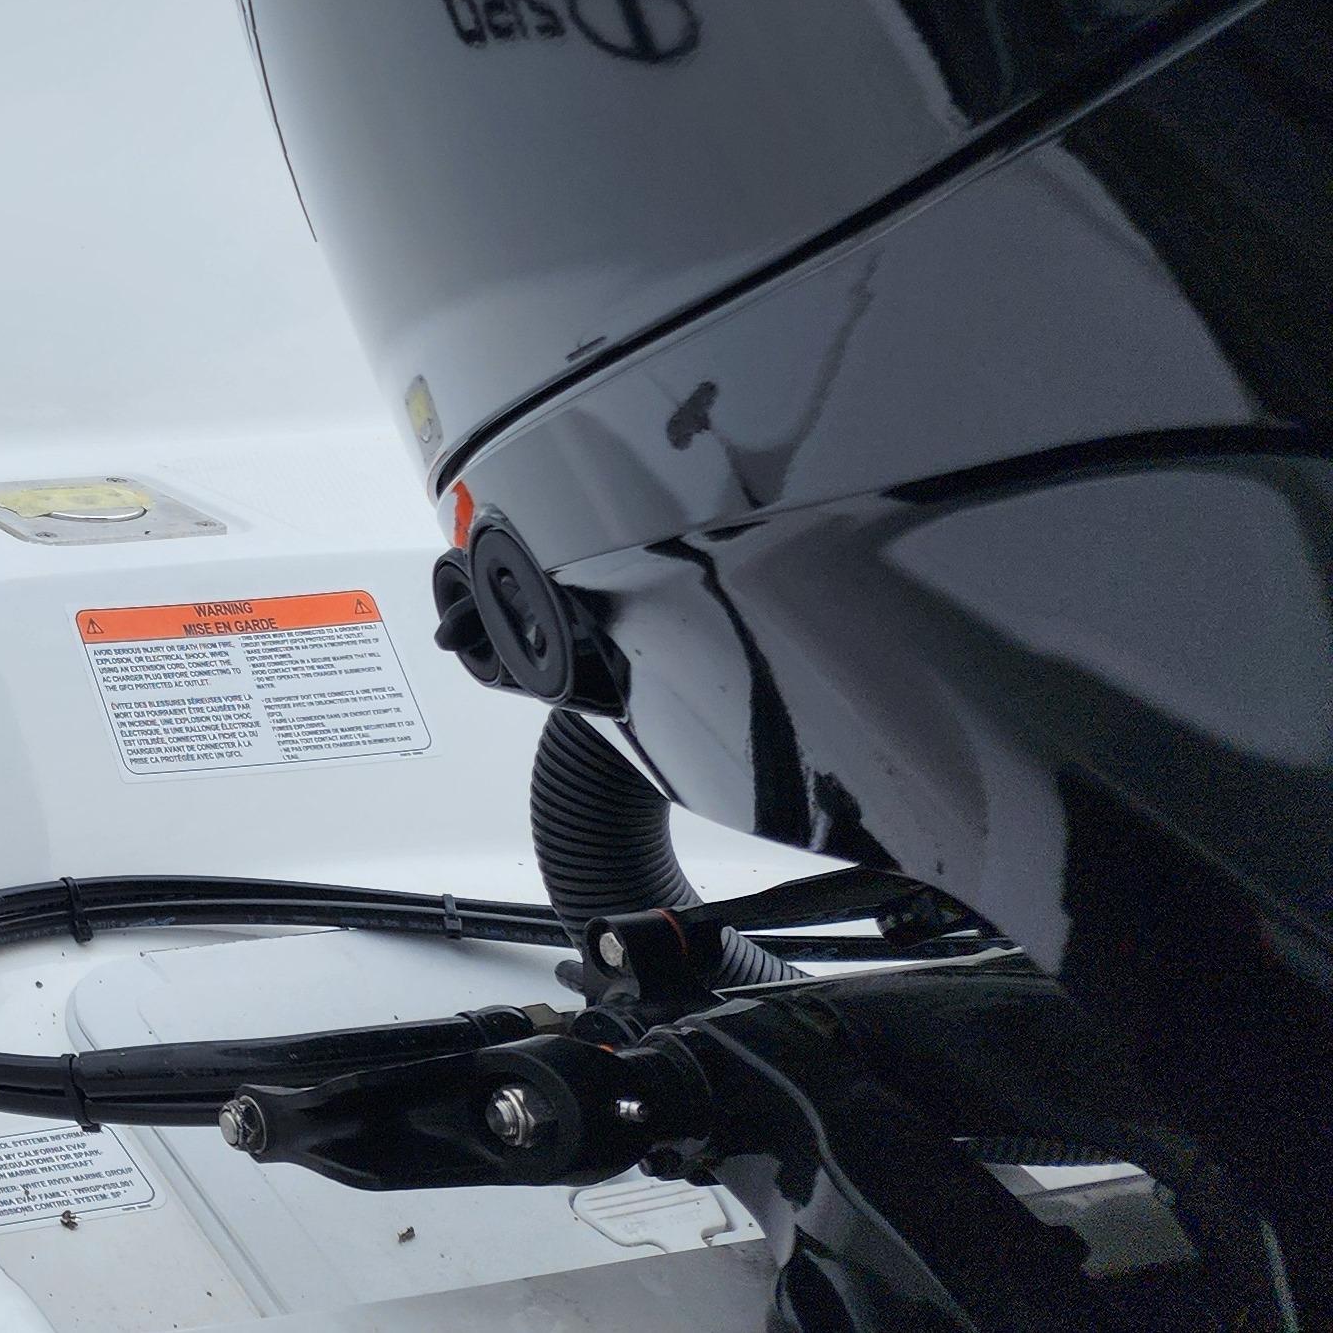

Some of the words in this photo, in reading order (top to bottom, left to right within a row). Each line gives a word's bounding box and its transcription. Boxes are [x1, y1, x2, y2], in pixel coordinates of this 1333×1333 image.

[194, 603, 253, 617] WARNING
[183, 623, 213, 635] MISE
[215, 622, 232, 633] EN
[234, 618, 278, 631] GARDE
[135, 682, 173, 690] PROTECTED
[148, 699, 186, 707] BLESSURES
[187, 696, 222, 704] SÉRIEUSES
[147, 708, 187, 716] POURRAIENT
[175, 716, 211, 724] EXPLOSION
[185, 724, 220, 732] RALLONGE
[221, 721, 261, 730] ÉLECTRIQUE
[168, 735, 208, 743] CONNECTER
[197, 742, 236, 750] CONNECTER
[12, 1137, 49, 1147] SYSTEMS
[17, 1146, 66, 1158] CALIFORNIA
[8, 1169, 39, 1177] MARINE
[39, 1160, 95, 1173] WATERCRAFT
[20, 1181, 47, 1190] WHITE
[47, 1177, 73, 1186] RIVER
[73, 1172, 105, 1182] MARINE
[104, 1167, 135, 1176] GROUP
[38, 1190, 72, 1200] FAMILY:
[34, 1200, 74, 1210] CONTROL
[74, 1194, 110, 1204] SYSTEM:
